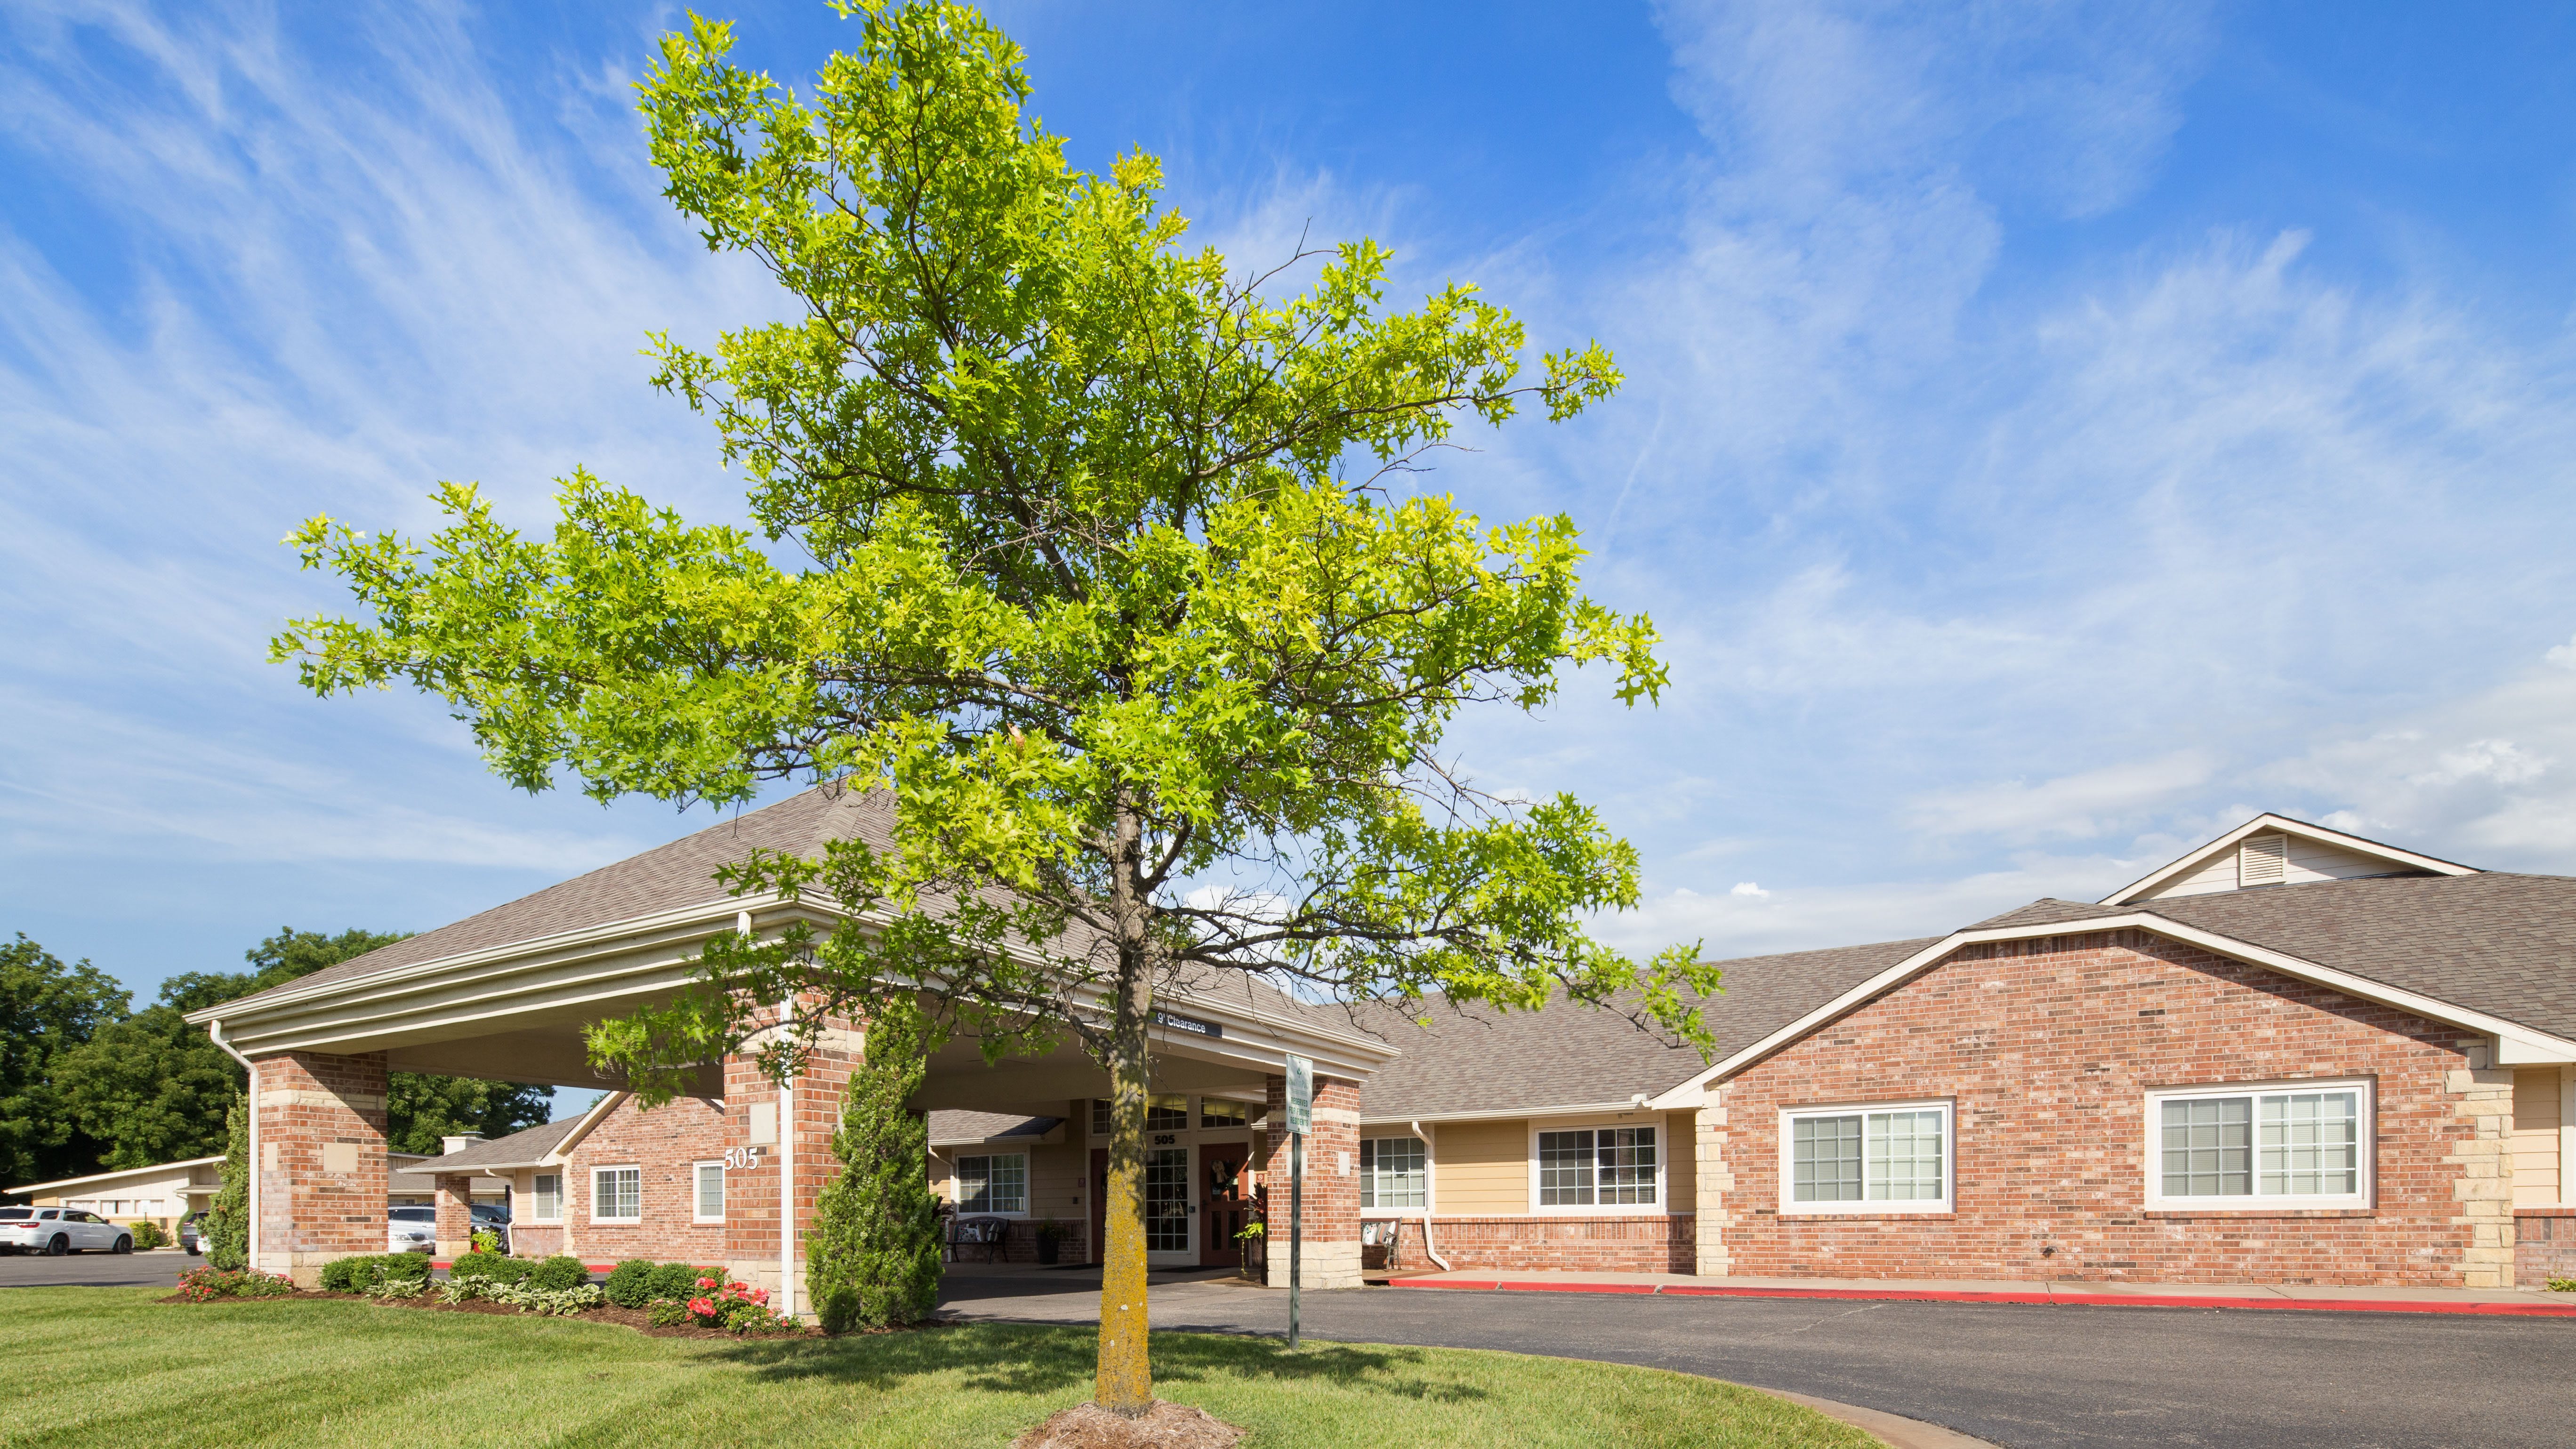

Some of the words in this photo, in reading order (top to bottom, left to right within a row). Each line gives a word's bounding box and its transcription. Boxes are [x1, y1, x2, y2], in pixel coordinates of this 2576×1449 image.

[1167, 1014, 1206, 1033] Clearance
[1291, 1096, 1308, 1107] RESERVED
[1296, 1108, 1310, 1117] FUTURE
[1290, 1116, 1308, 1127] RESIDENTS
[1154, 1135, 1175, 1145] 505
[725, 1147, 758, 1171] 505
